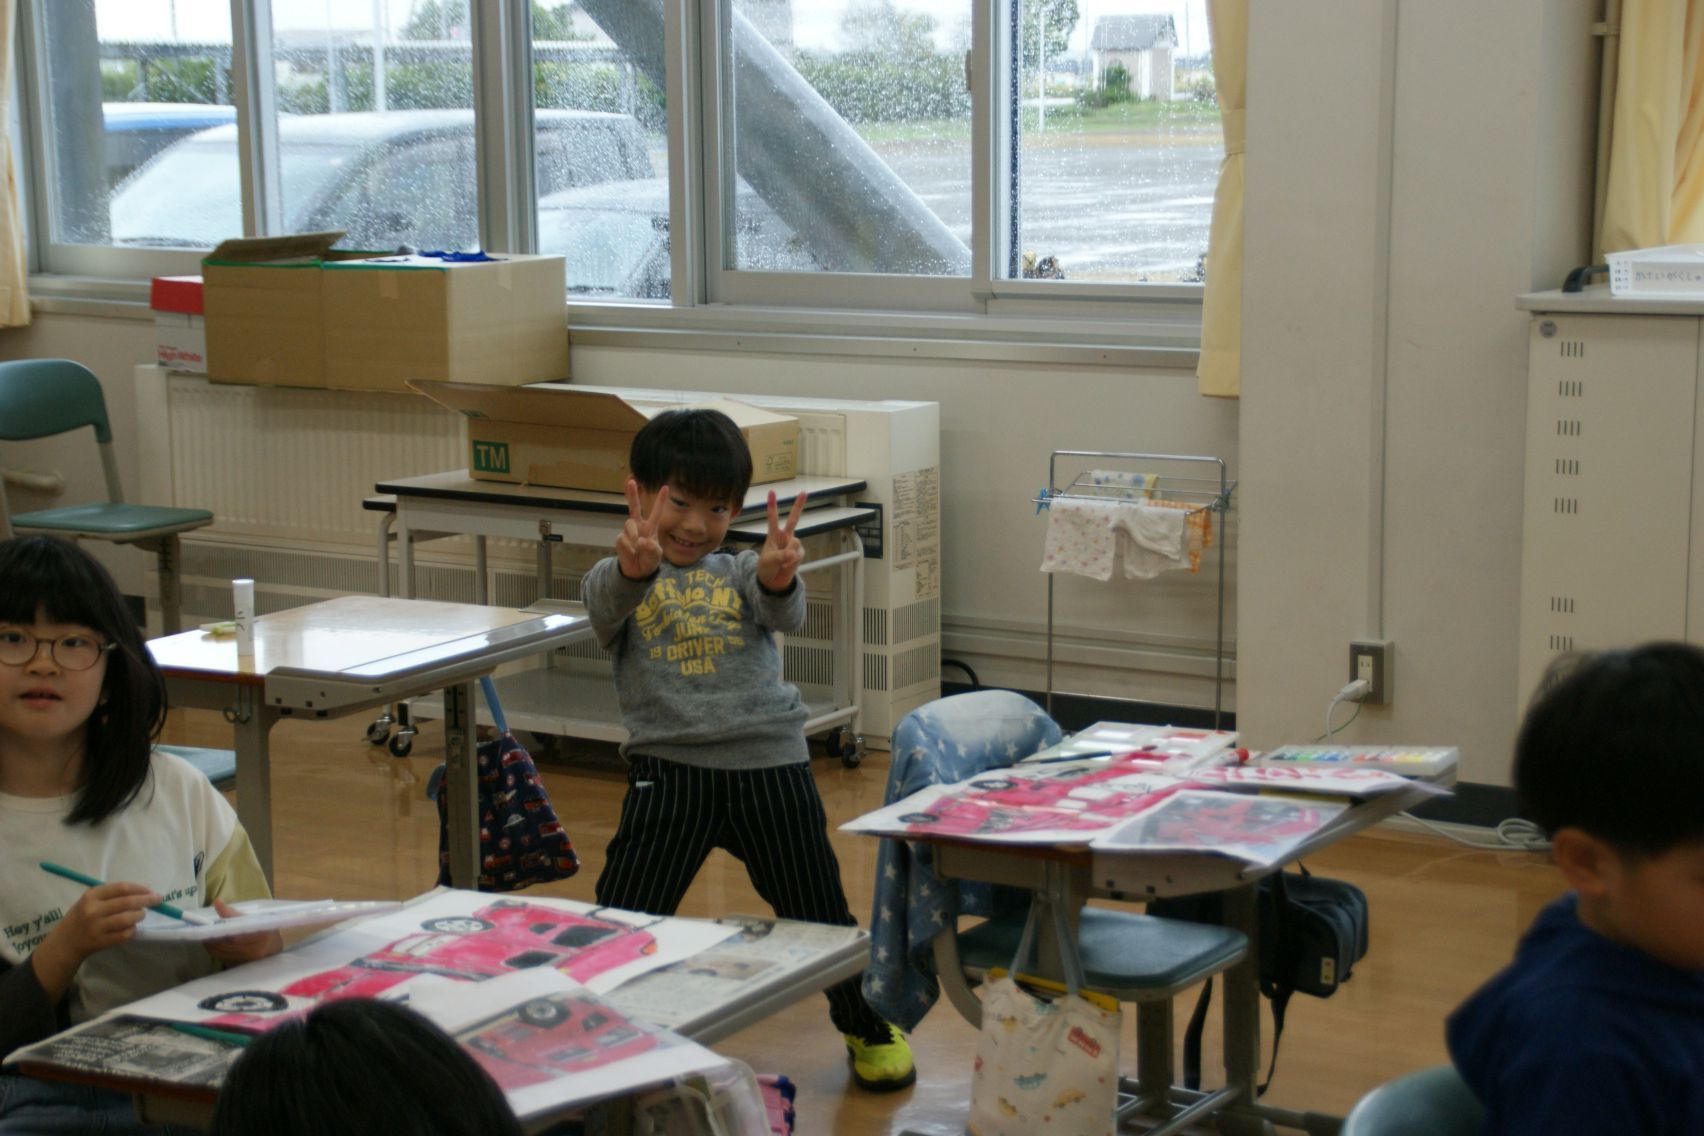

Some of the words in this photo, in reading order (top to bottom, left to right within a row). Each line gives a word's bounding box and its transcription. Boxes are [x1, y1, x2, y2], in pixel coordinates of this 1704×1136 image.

[476, 445, 506, 469] TM
[666, 636, 725, 661] DRIVER
[681, 657, 717, 676] USA
[3, 922, 31, 939] Hey
